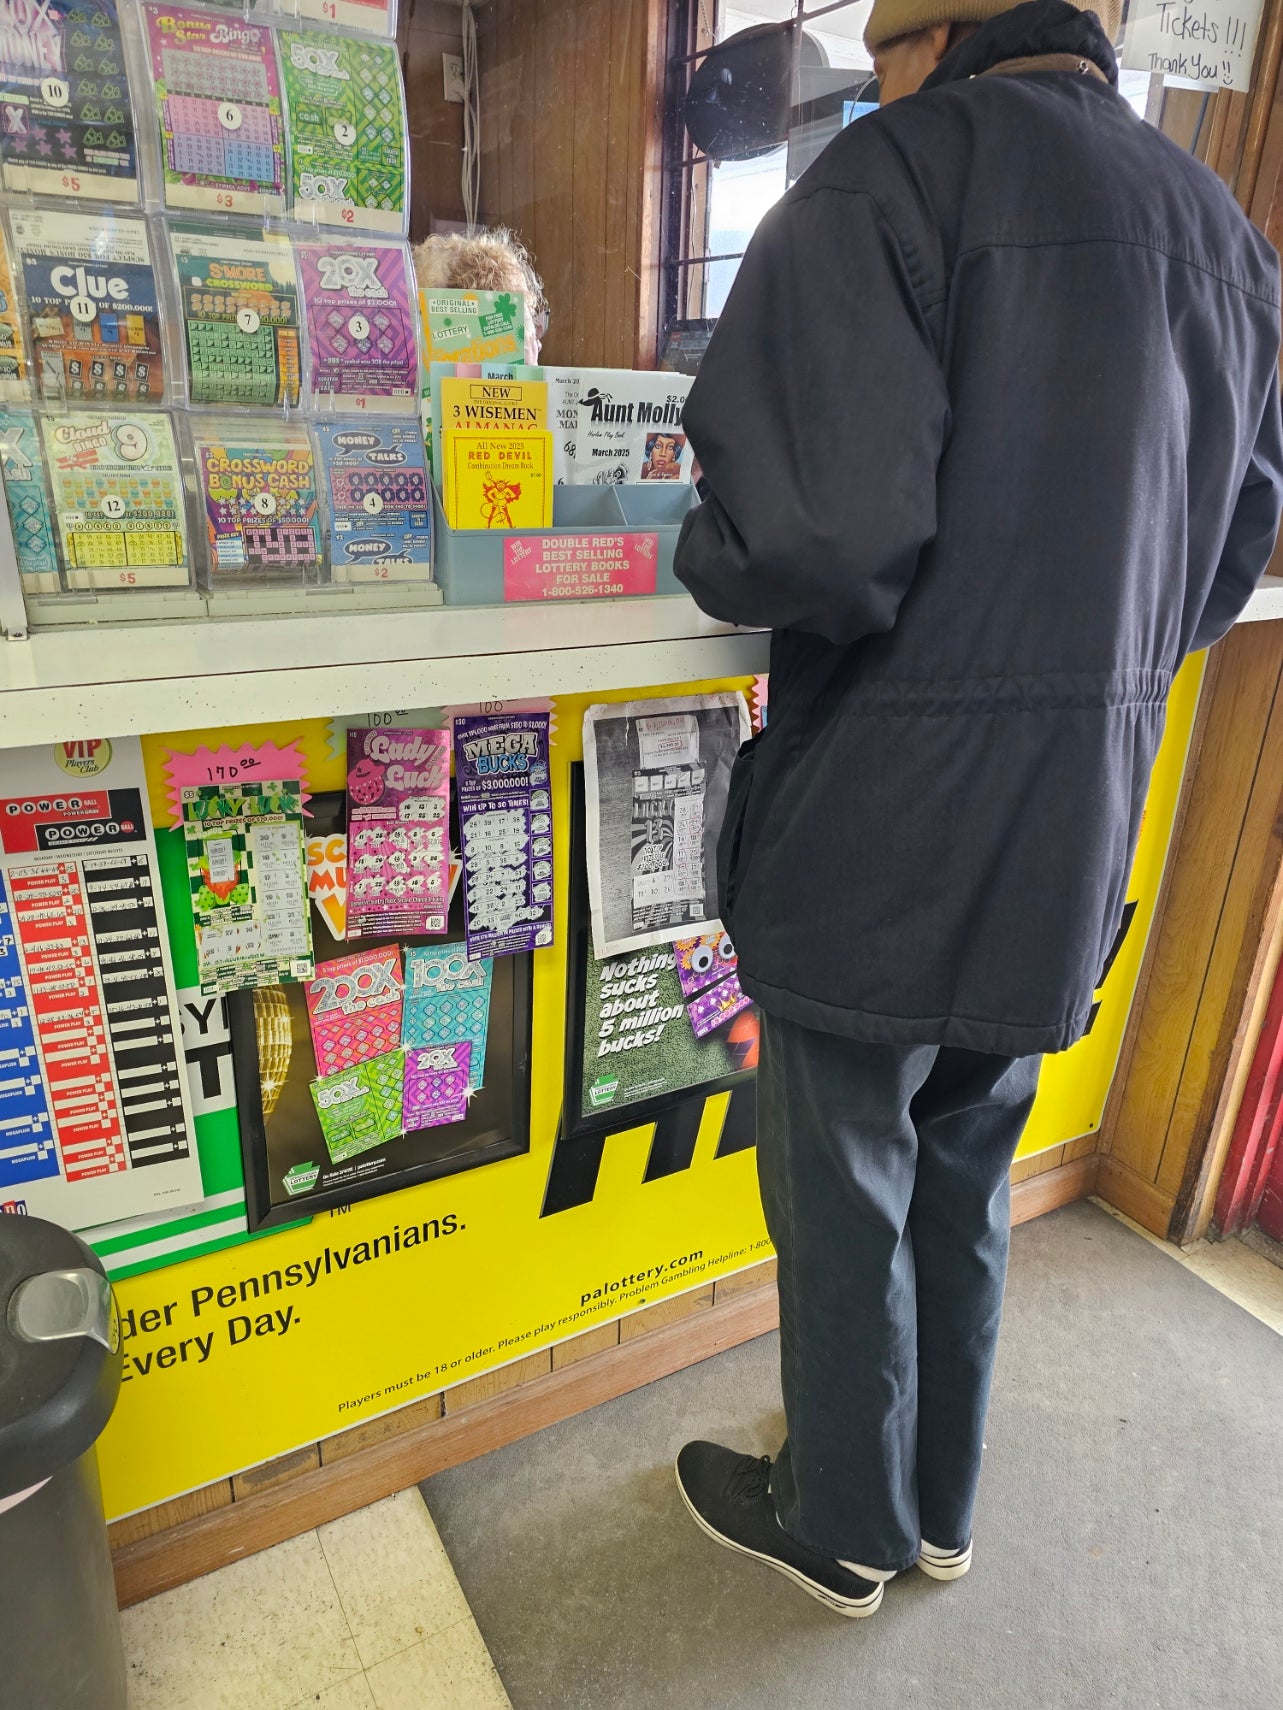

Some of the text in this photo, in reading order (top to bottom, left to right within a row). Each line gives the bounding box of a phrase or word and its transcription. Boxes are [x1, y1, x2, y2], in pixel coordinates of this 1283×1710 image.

[322, 2, 336, 19] $1
[209, 24, 261, 44] Bingo
[290, 43, 339, 74] 50X
[1148, 52, 1217, 80] Thank You
[48, 84, 62, 98] 10
[226, 109, 234, 122] 6
[341, 126, 348, 137] 2
[62, 176, 81, 192] $5
[299, 172, 348, 200] 50X
[217, 194, 233, 208] $3
[341, 209, 354, 223] $2
[317, 255, 382, 290] 20X
[51, 265, 129, 300] Clue
[206, 278, 273, 292] CROSSWORD
[31, 295, 42, 303] 10
[44, 296, 62, 304] TOP
[112, 303, 153, 313] $200,000!
[77, 302, 89, 315] 11
[323, 298, 336, 306] top
[244, 314, 251, 325] 7
[355, 321, 362, 333] 3
[432, 325, 468, 340] LOTTERY
[487, 372, 514, 380] March
[482, 386, 511, 399] NEW
[355, 398, 366, 409] $1
[453, 405, 538, 420] 3 WISEMEN
[590, 400, 683, 427] Aunt Molly
[55, 420, 148, 462] Cloud 9
[72, 437, 108, 451] BINGO
[337, 435, 376, 446] MONEY
[476, 442, 488, 450] All
[490, 442, 507, 450] New
[368, 452, 404, 462] TALKS
[468, 451, 532, 460] RED DEVIL
[591, 448, 630, 457] March 2025
[206, 458, 310, 474] CROSSWORD
[467, 462, 501, 470] Combination
[520, 462, 534, 470] Book
[208, 473, 310, 490] BONUS CASH
[107, 500, 120, 512] 12
[261, 498, 269, 509] 8
[369, 498, 376, 508] 4
[349, 543, 387, 553] MONEY
[542, 537, 625, 549] DOUBLE RED'S
[511, 547, 532, 565] LOTTERY
[542, 549, 623, 561] BEST SELLING
[374, 567, 388, 578] $2
[535, 560, 630, 574] LOTTERY BOOKS
[119, 572, 136, 584] $5
[556, 573, 611, 584] FOR SALE
[542, 584, 624, 597] 1-800-526-1340
[479, 701, 503, 714] 100
[367, 712, 392, 727] 100
[62, 738, 102, 758] VIP
[370, 735, 437, 766] Lady
[464, 733, 537, 760] MEGA
[65, 759, 95, 768] Players
[80, 765, 99, 774] Club
[477, 753, 528, 774] BUCKS
[385, 764, 443, 791] Luck
[481, 777, 529, 791] $3,000,000!
[6, 798, 82, 816] POWER
[187, 796, 246, 820] LUCKY
[463, 804, 477, 812] WIN
[478, 802, 487, 810] UP
[45, 822, 120, 840] POWER
[410, 953, 488, 989] 100X
[599, 952, 677, 982] Nothing
[310, 958, 399, 1015] 200X
[600, 973, 659, 1000] sucks
[341, 988, 401, 1016] the cash
[599, 989, 660, 1019] about
[598, 1003, 685, 1039] 5 million
[597, 1023, 667, 1059] bucks!
[416, 1047, 458, 1070] 20X
[317, 1076, 360, 1109] 50X
[289, 1173, 319, 1186] LOTTERY
[121, 1213, 466, 1341] der Pennsylvanians.
[580, 1249, 703, 1307] palottery.com
[338, 1390, 382, 1413] Players
[384, 1378, 414, 1395] must
[416, 1371, 431, 1382] be
[434, 1363, 448, 1375] 18
[450, 1359, 462, 1369] or
[464, 1346, 496, 1363] older.
[497, 1330, 532, 1350] Please
[533, 1320, 556, 1337] play
[557, 1294, 618, 1326] responsibly.
[619, 1281, 659, 1302] Problem
[661, 1263, 706, 1285] Gambling
[707, 1247, 747, 1268] Helpline:
[121, 1305, 301, 1383] Every Day.
